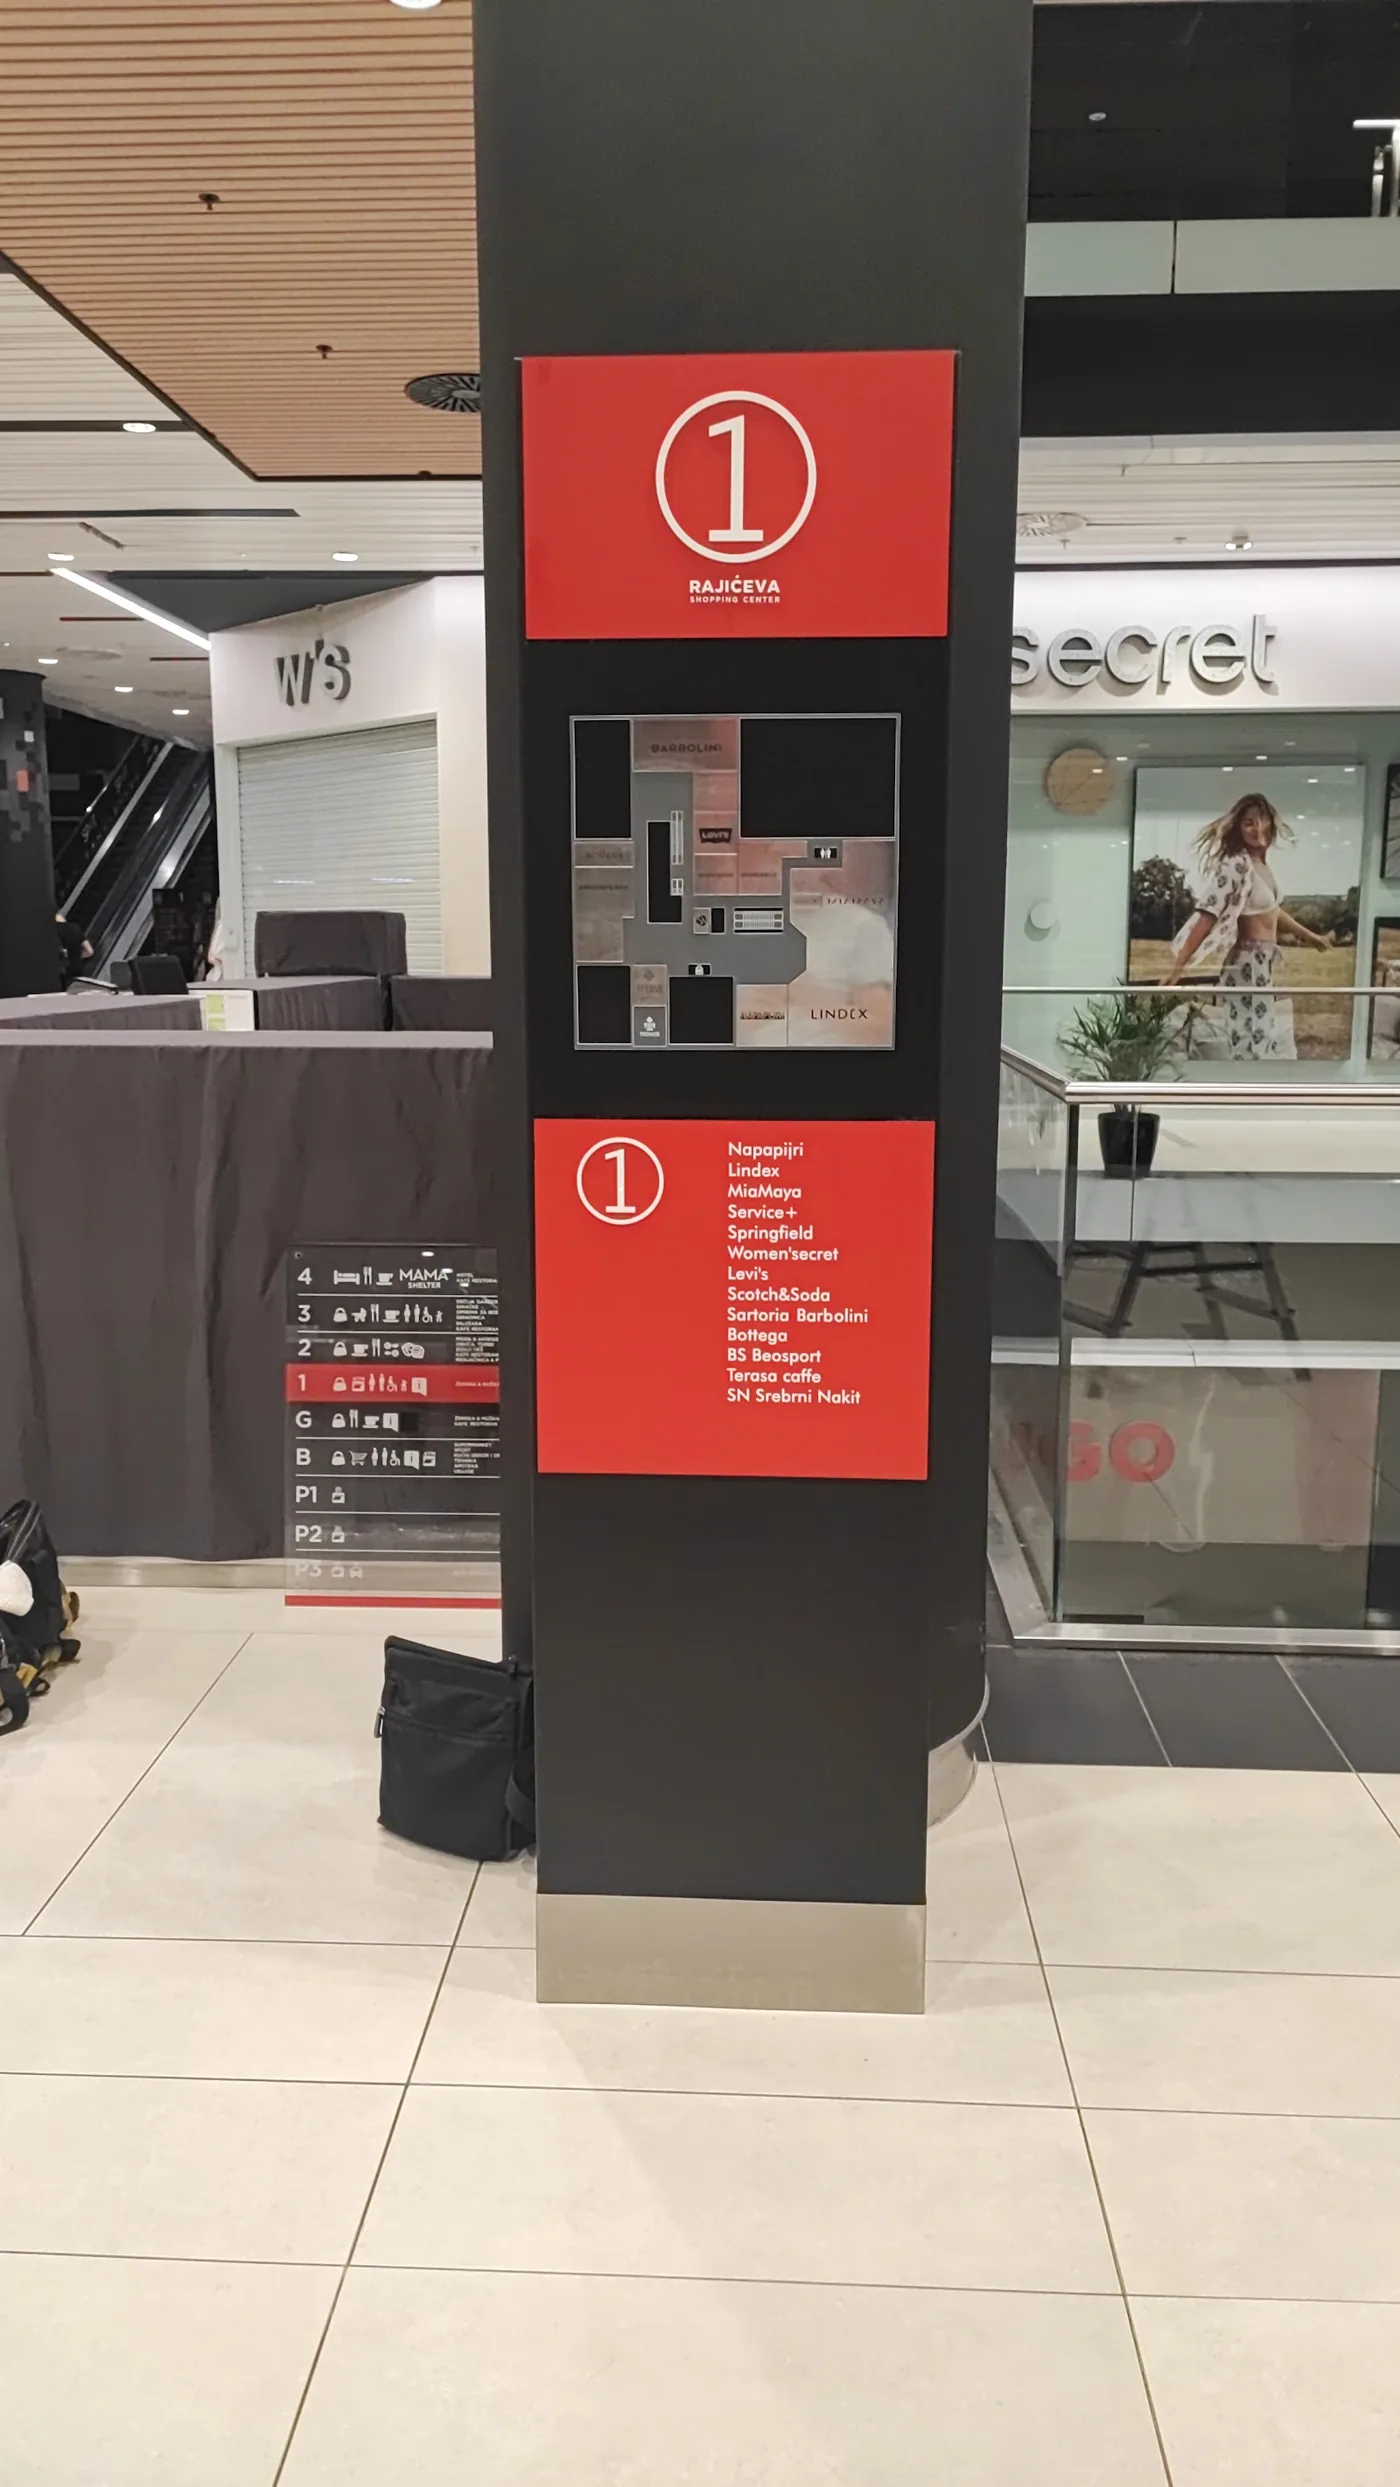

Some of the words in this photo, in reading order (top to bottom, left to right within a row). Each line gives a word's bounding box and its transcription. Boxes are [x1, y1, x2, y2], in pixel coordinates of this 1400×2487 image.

[709, 414, 763, 542] 1
[689, 575, 781, 593] RAJIĆEVA
[689, 595, 739, 603] SHOPPING
[743, 595, 780, 603] CENTER
[1012, 614, 1277, 686] secret
[811, 1008, 868, 1020] LINDEX
[728, 1142, 804, 1158] Napapijri
[728, 1162, 780, 1178] Lindex
[604, 1149, 636, 1214] 1
[728, 1184, 802, 1201] MiaMaya
[728, 1204, 798, 1220] Service+
[728, 1225, 814, 1242] Springfield
[727, 1246, 839, 1261] Women'secret
[297, 1267, 313, 1285] 4
[400, 1269, 448, 1281] MAMA
[728, 1266, 769, 1281] Levi's
[408, 1281, 441, 1289] SHELTER
[727, 1286, 831, 1302] Scotch&Soda
[297, 1305, 311, 1322] 3
[727, 1306, 790, 1322] Sartoria
[796, 1308, 868, 1323] Barbolini
[728, 1327, 788, 1346] Bottega
[297, 1339, 311, 1356] 2
[728, 1347, 747, 1361] BS
[752, 1348, 822, 1366] Beosport
[298, 1373, 306, 1391] 1
[727, 1368, 778, 1383] Terasa
[782, 1368, 822, 1383] caffe
[727, 1388, 750, 1402] SN
[755, 1388, 812, 1403] Srebrni
[817, 1389, 861, 1404] Nakit
[296, 1411, 311, 1428] G
[296, 1448, 311, 1465] B
[296, 1486, 318, 1503] P1
[295, 1525, 322, 1543] P2
[295, 1559, 322, 1577] P3
